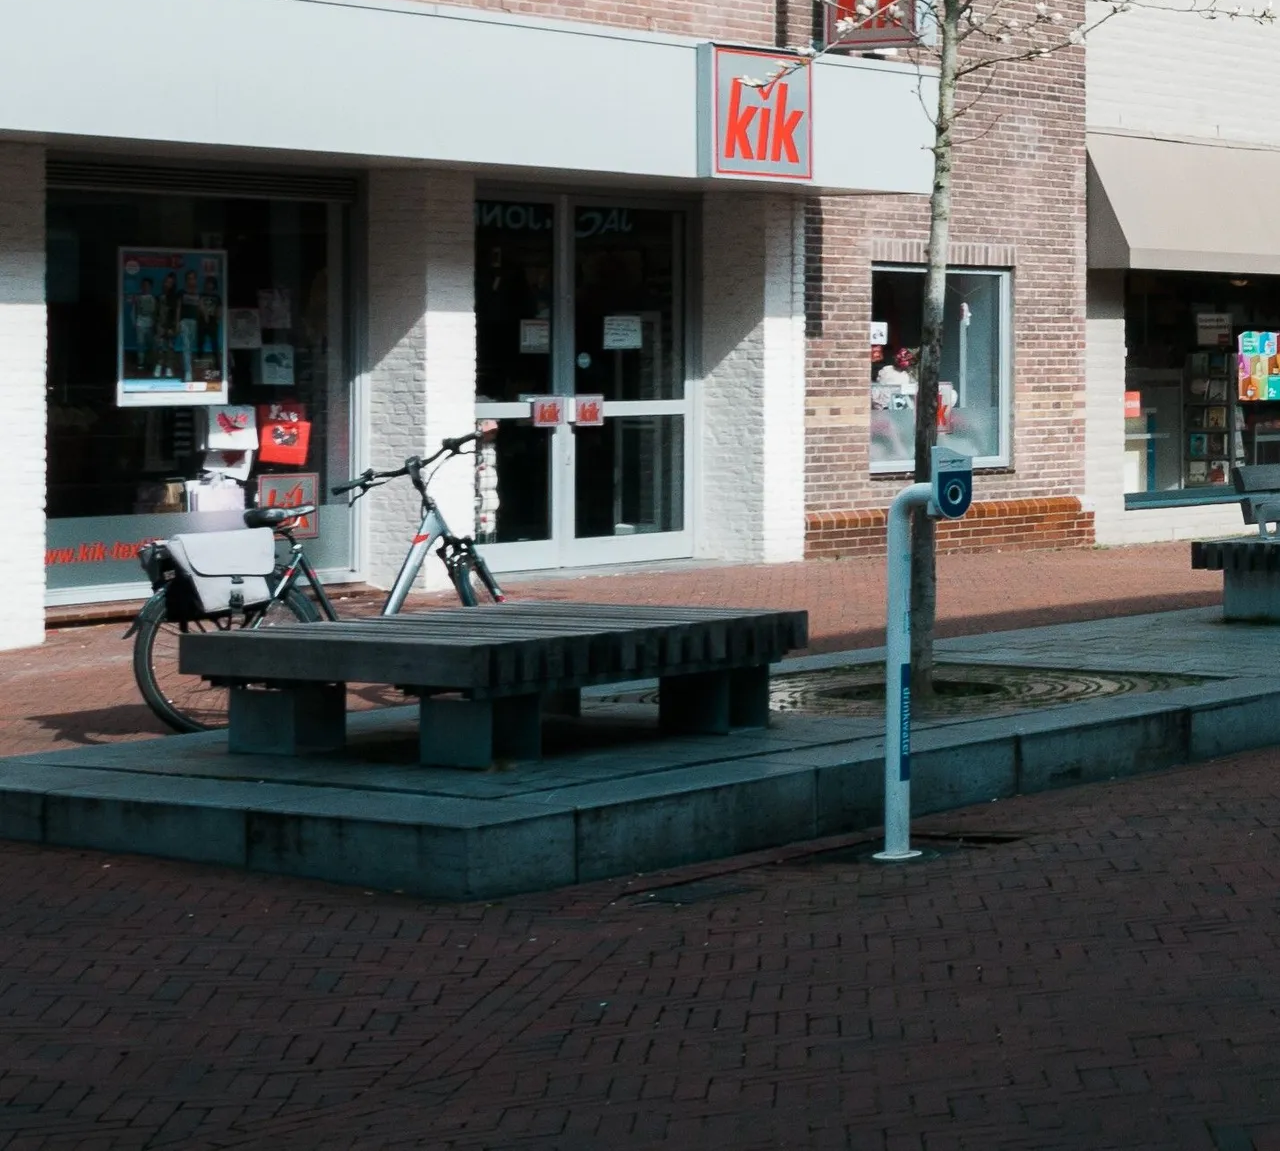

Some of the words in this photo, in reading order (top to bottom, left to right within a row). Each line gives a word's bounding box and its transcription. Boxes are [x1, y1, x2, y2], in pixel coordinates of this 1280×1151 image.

[724, 69, 804, 163] kik
[539, 402, 560, 423] kik
[579, 401, 600, 422] kik
[902, 687, 911, 756] drinkwater
